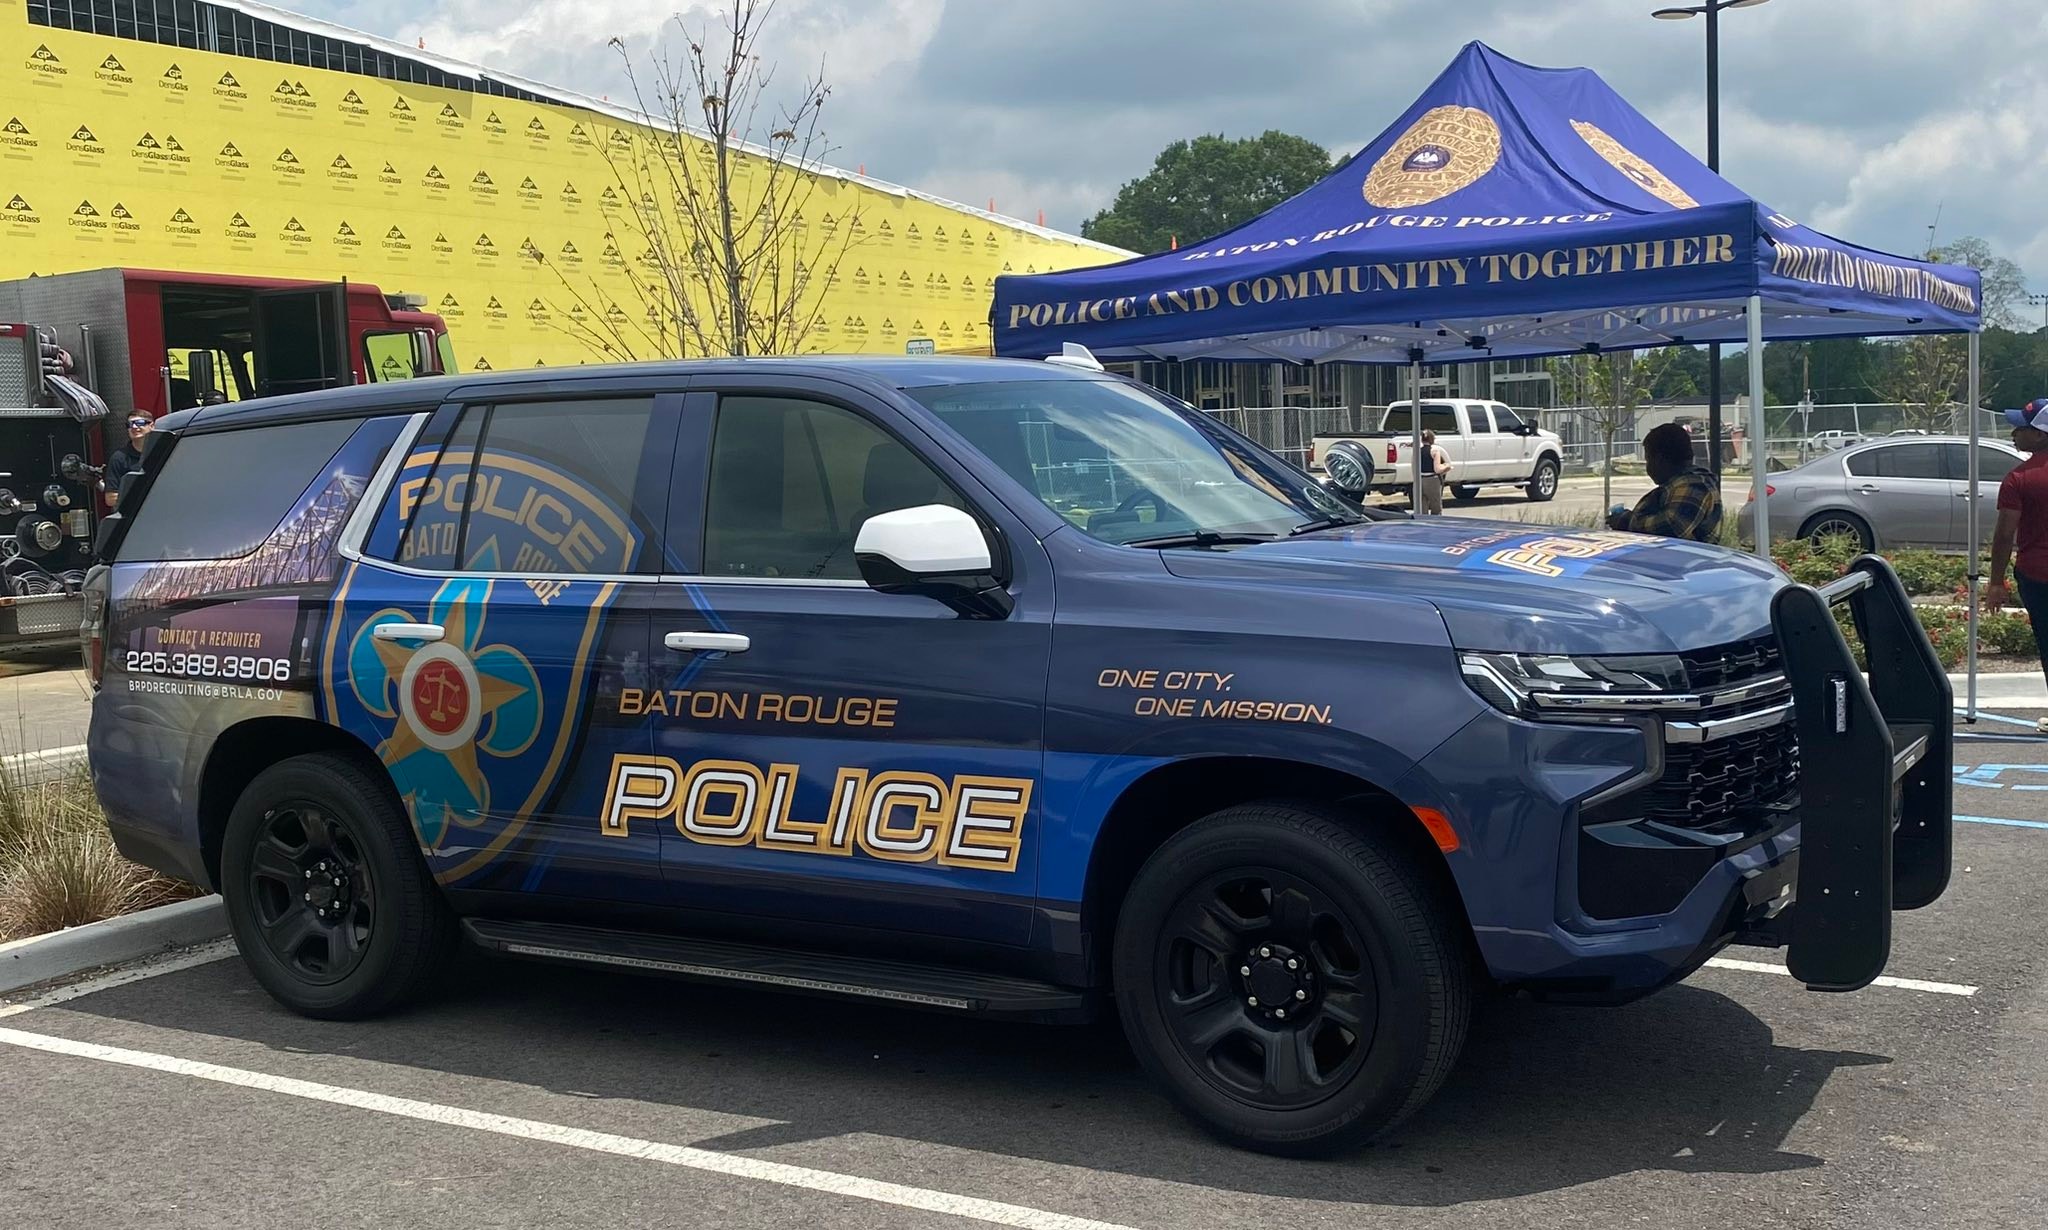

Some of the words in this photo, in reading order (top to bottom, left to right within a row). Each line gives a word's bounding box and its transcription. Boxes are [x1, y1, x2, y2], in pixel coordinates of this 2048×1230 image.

[25, 61, 67, 74] DensGlass
[95, 71, 133, 83] DensGlass
[213, 88, 247, 99] DensGlass
[0, 136, 38, 147] ensGlass
[66, 142, 105, 154] DensGlass
[215, 158, 249, 168] DensGlass
[0, 213, 40, 223] DensGlass
[68, 218, 107, 228] DensGlass
[165, 225, 201, 234] DensGlass
[1182, 236, 1303, 262] BATON
[1310, 215, 1451, 243] ROUGE
[1455, 212, 1613, 229] POLICE
[1008, 296, 1138, 330] POLICE
[1146, 285, 1220, 317] AND
[1227, 258, 1474, 309] COMMUNITY
[1478, 233, 1736, 285] TOGETHER
[399, 473, 606, 572] POLICE
[158, 628, 198, 645] CONTACT
[200, 631, 206, 645] A
[208, 631, 262, 648] RECRUITER
[126, 651, 290, 681] 225.389.3906
[128, 680, 283, 700] BRPDRECRUITING@BRLA.GOV
[1098, 669, 1159, 689] ONE
[1164, 671, 1234, 691] CITY.
[619, 688, 749, 720] BATON
[756, 693, 898, 727] ROUGE
[1135, 697, 1196, 717] ONE
[1200, 699, 1332, 724] MISSION.
[600, 753, 1034, 873] POLICE
